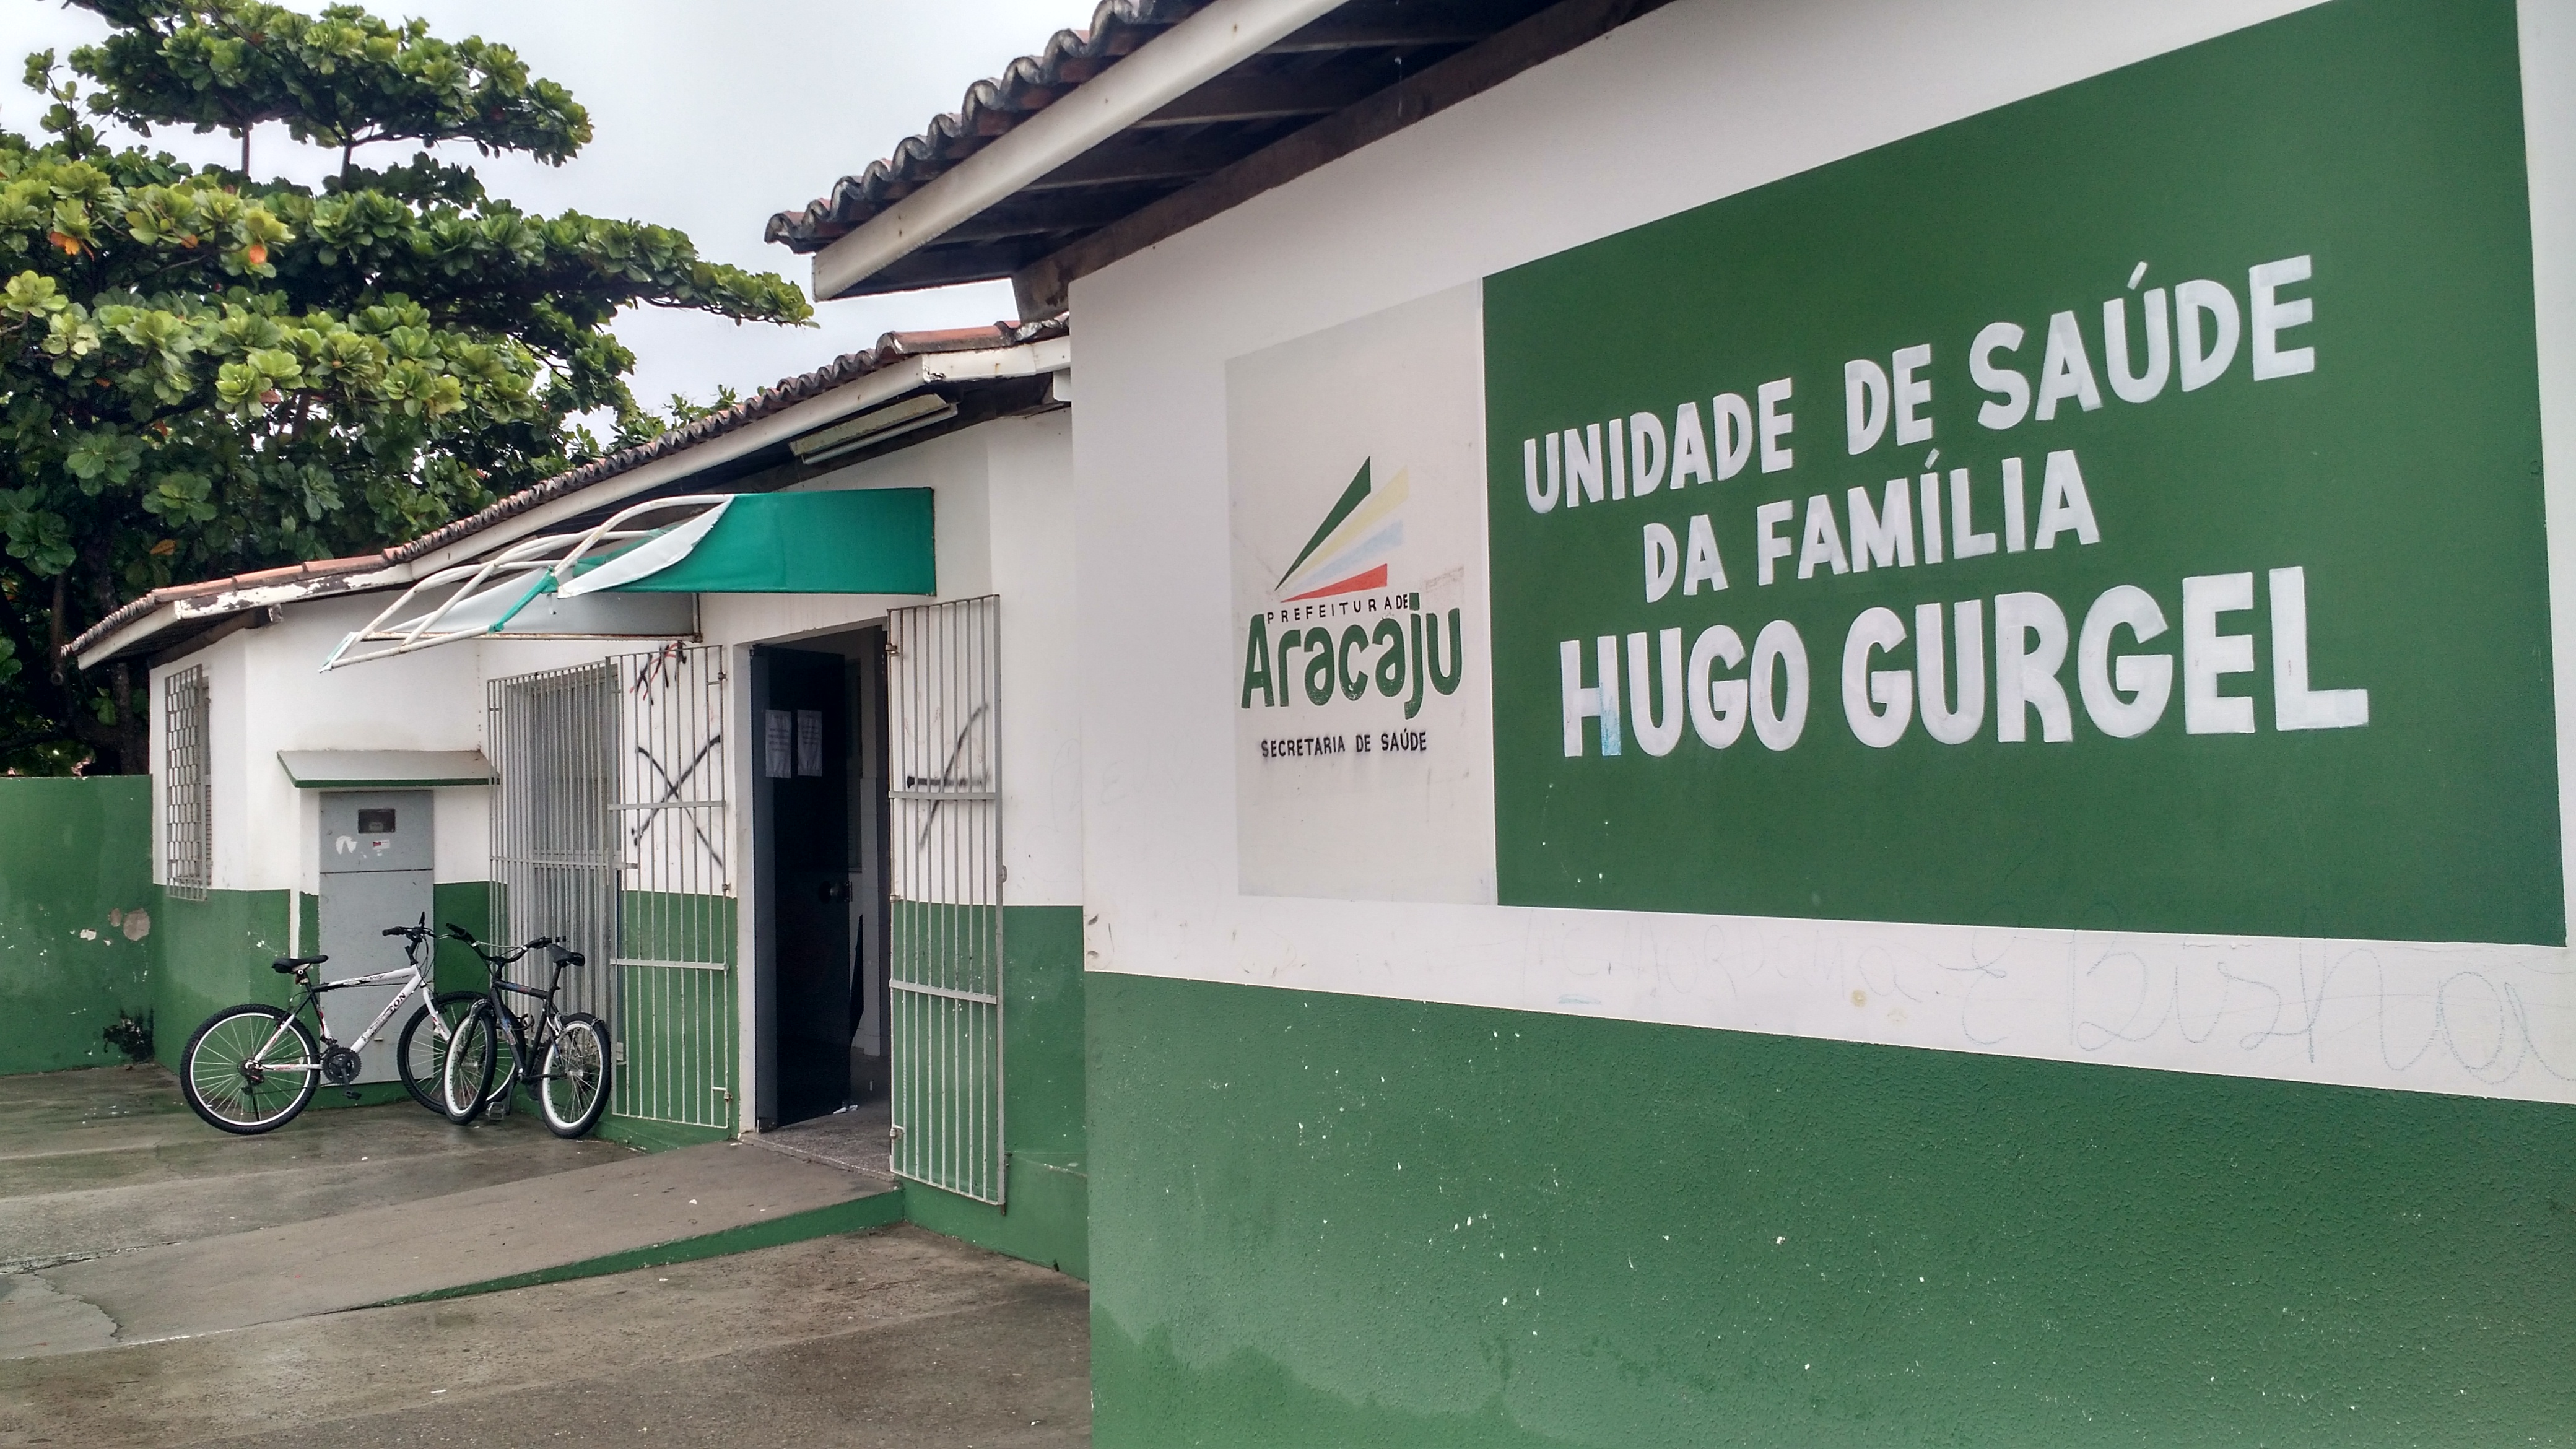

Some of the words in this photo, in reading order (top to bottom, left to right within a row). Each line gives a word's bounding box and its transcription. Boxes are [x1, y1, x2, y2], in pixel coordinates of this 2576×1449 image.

[1523, 377, 1794, 514] UNIDADE
[1844, 343, 1934, 456] DE
[1969, 254, 2316, 430] SAÚDE
[1643, 513, 1729, 604] DA
[1757, 448, 2101, 587] FAMÍLIA
[1240, 591, 1463, 720] Aracaju
[1267, 594, 1393, 624] PREFEITURA
[1396, 593, 1409, 610] DE
[1560, 620, 1809, 758] HUGO
[1842, 565, 2370, 749] GURGEL
[1261, 734, 1346, 759] SECRETARIA
[1355, 734, 1372, 753] DE
[1380, 727, 1427, 752] SAÚDE
